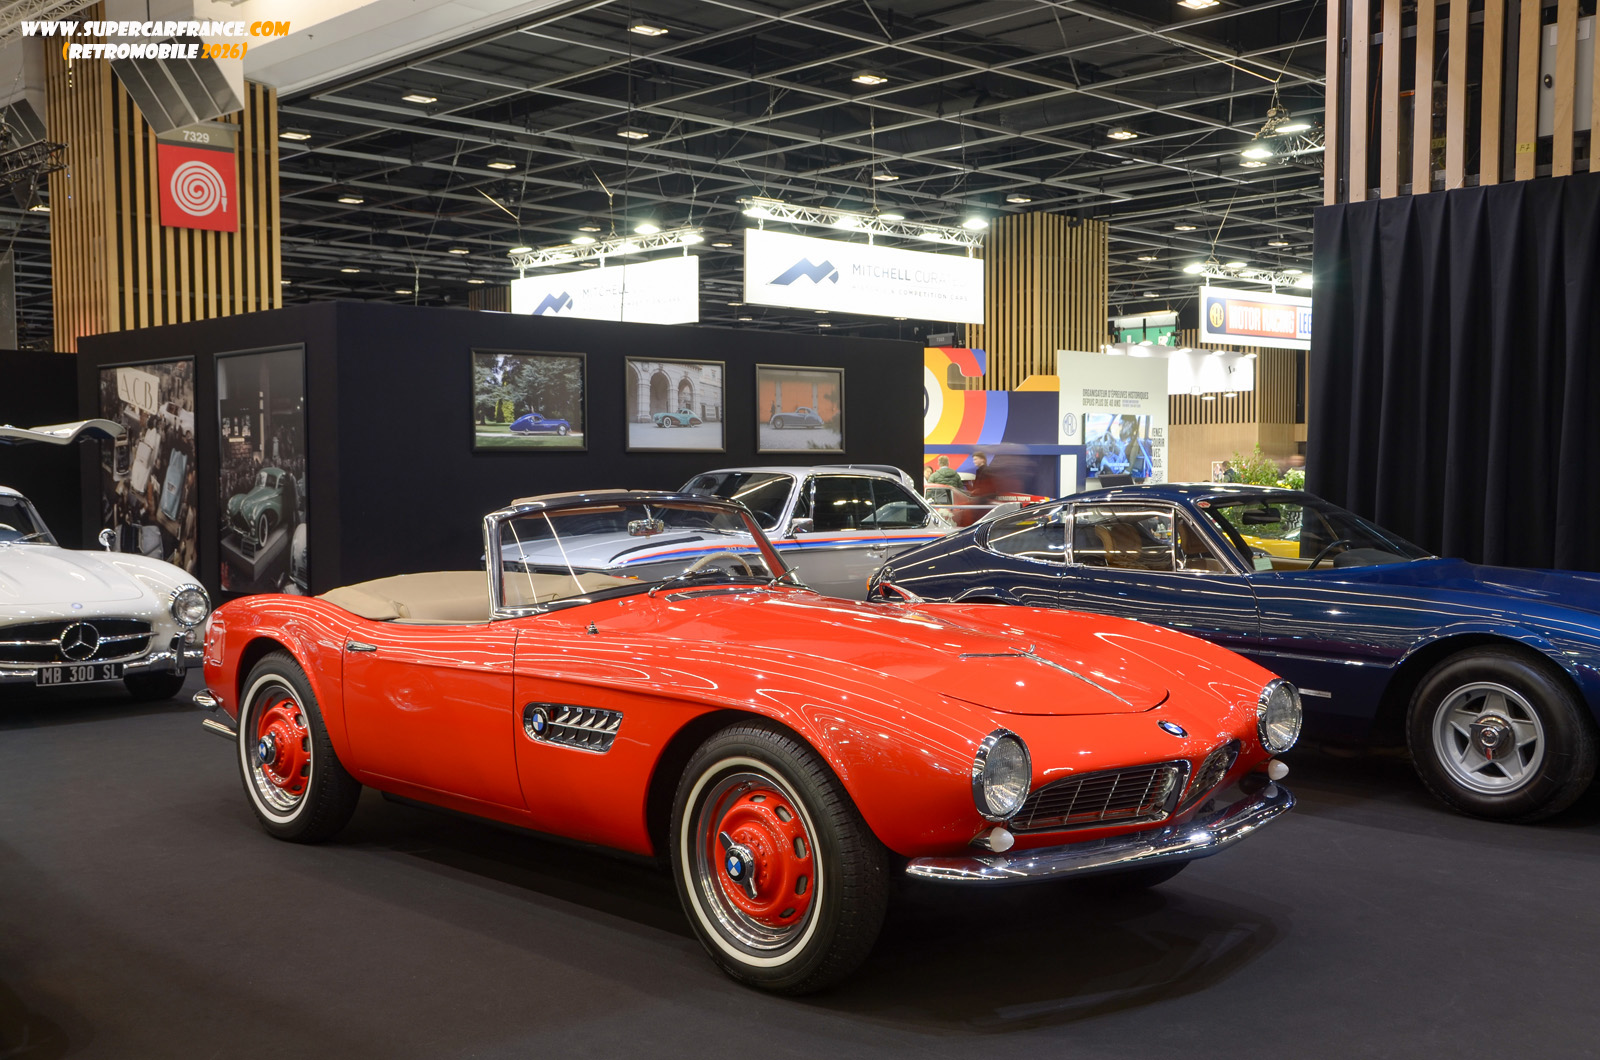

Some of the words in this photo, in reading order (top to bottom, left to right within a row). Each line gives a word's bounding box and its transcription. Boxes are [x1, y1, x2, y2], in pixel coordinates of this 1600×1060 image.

[183, 130, 210, 143] 7329
[852, 263, 911, 281] MITCHELL
[1229, 305, 1261, 331] MOTOR
[42, 668, 62, 684] MB
[69, 665, 95, 682] 300
[103, 664, 119, 680] SL
